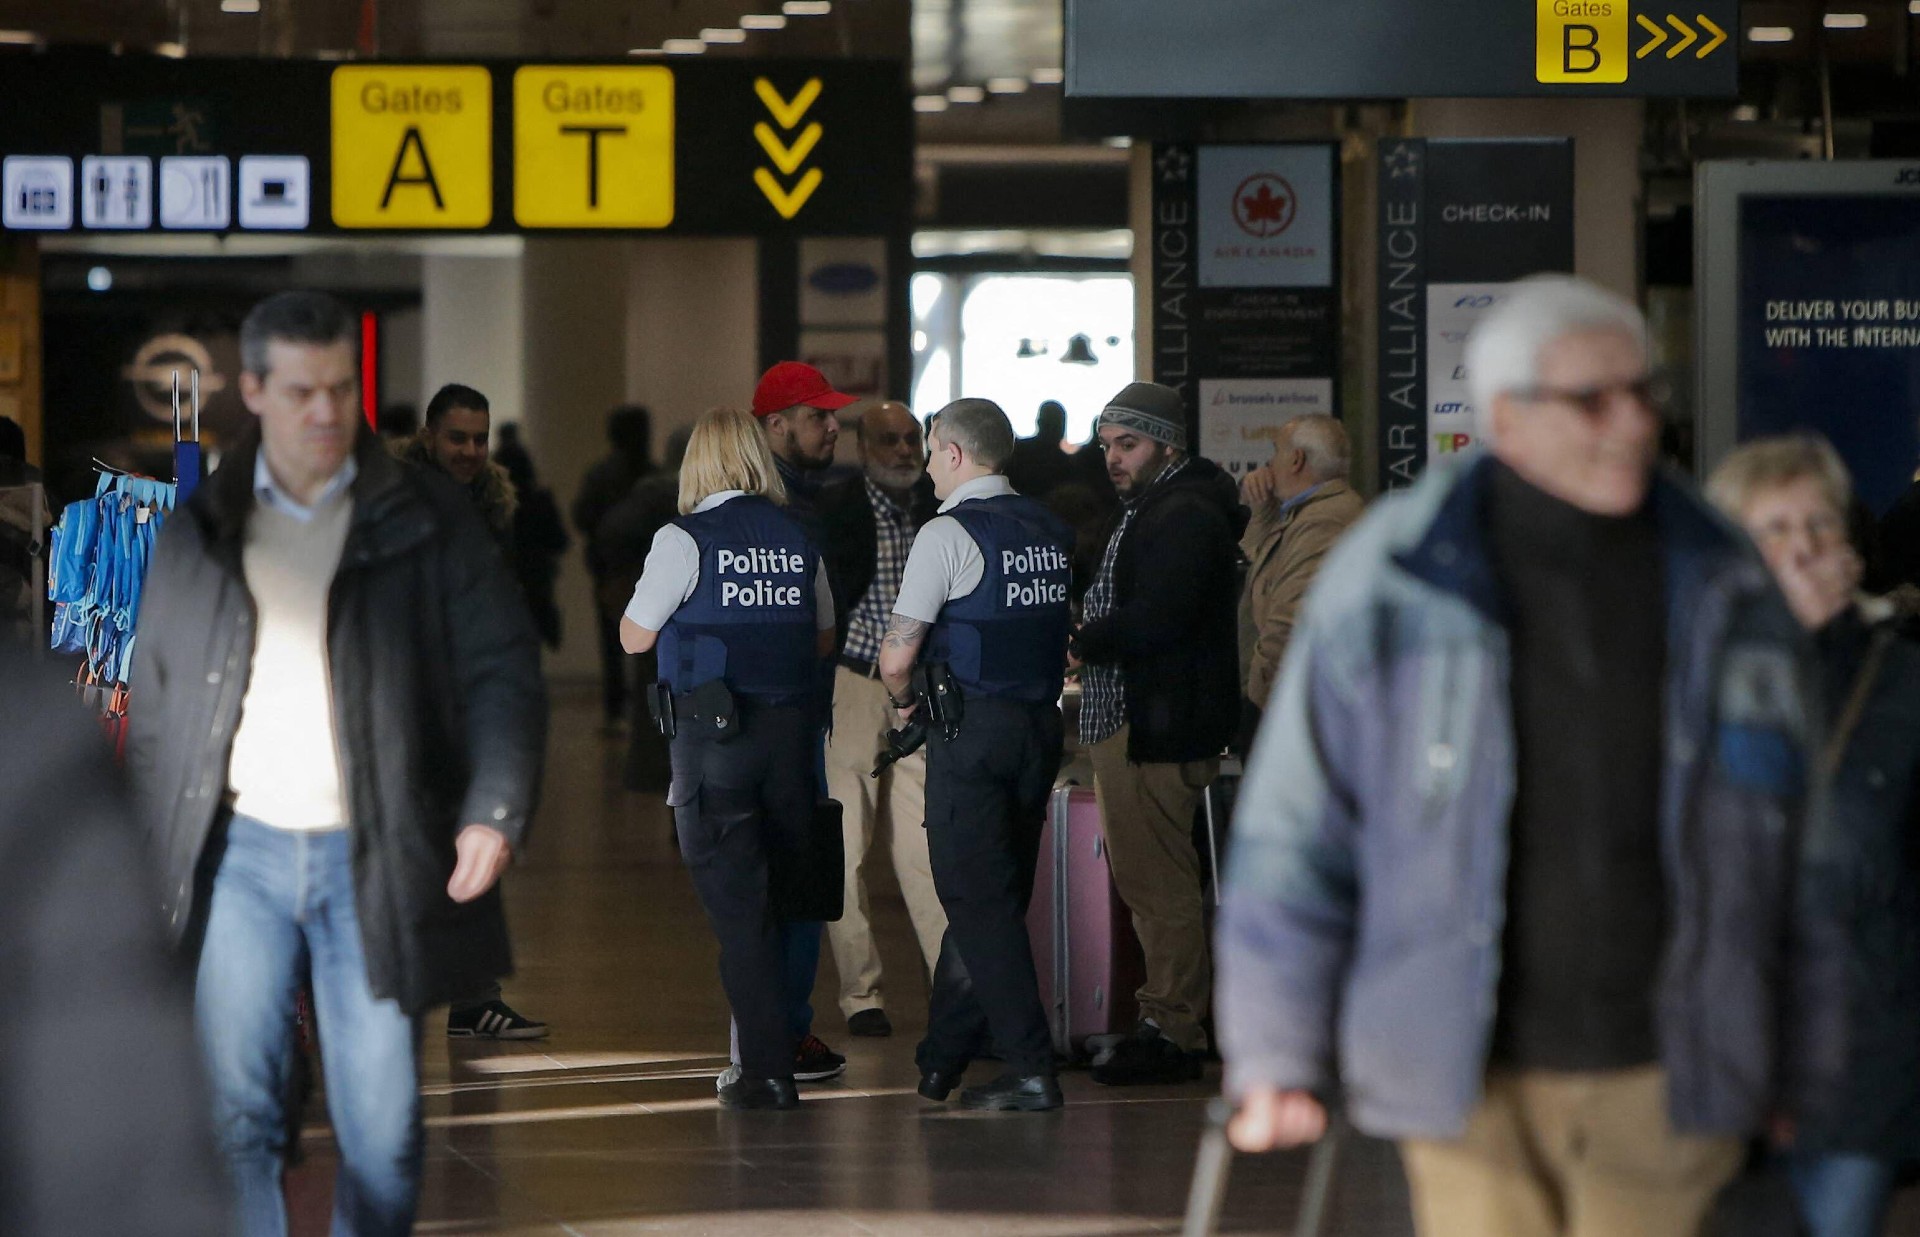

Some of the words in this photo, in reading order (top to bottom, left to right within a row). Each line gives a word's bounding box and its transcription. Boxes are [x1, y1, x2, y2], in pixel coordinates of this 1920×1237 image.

[1553, 0, 1612, 17] Gates
[1563, 24, 1601, 74] B
[360, 80, 464, 115] Gates
[543, 80, 645, 115] Gates
[379, 124, 446, 210] A
[558, 124, 628, 210] T
[1442, 204, 1550, 222] CHECK-IN
[1387, 202, 1417, 410] ALLIANCE
[1766, 300, 1835, 320] DELIVER
[1840, 300, 1889, 320] YOUR
[1765, 327, 1811, 347] WITH
[1816, 327, 1848, 347] THE
[1228, 392, 1275, 404] brussels
[1277, 392, 1319, 404] airlines
[1434, 402, 1463, 414] LOT
[718, 547, 804, 574] Politie
[1002, 545, 1068, 575] Politie
[722, 579, 801, 607] Police
[1006, 578, 1066, 607] Police
